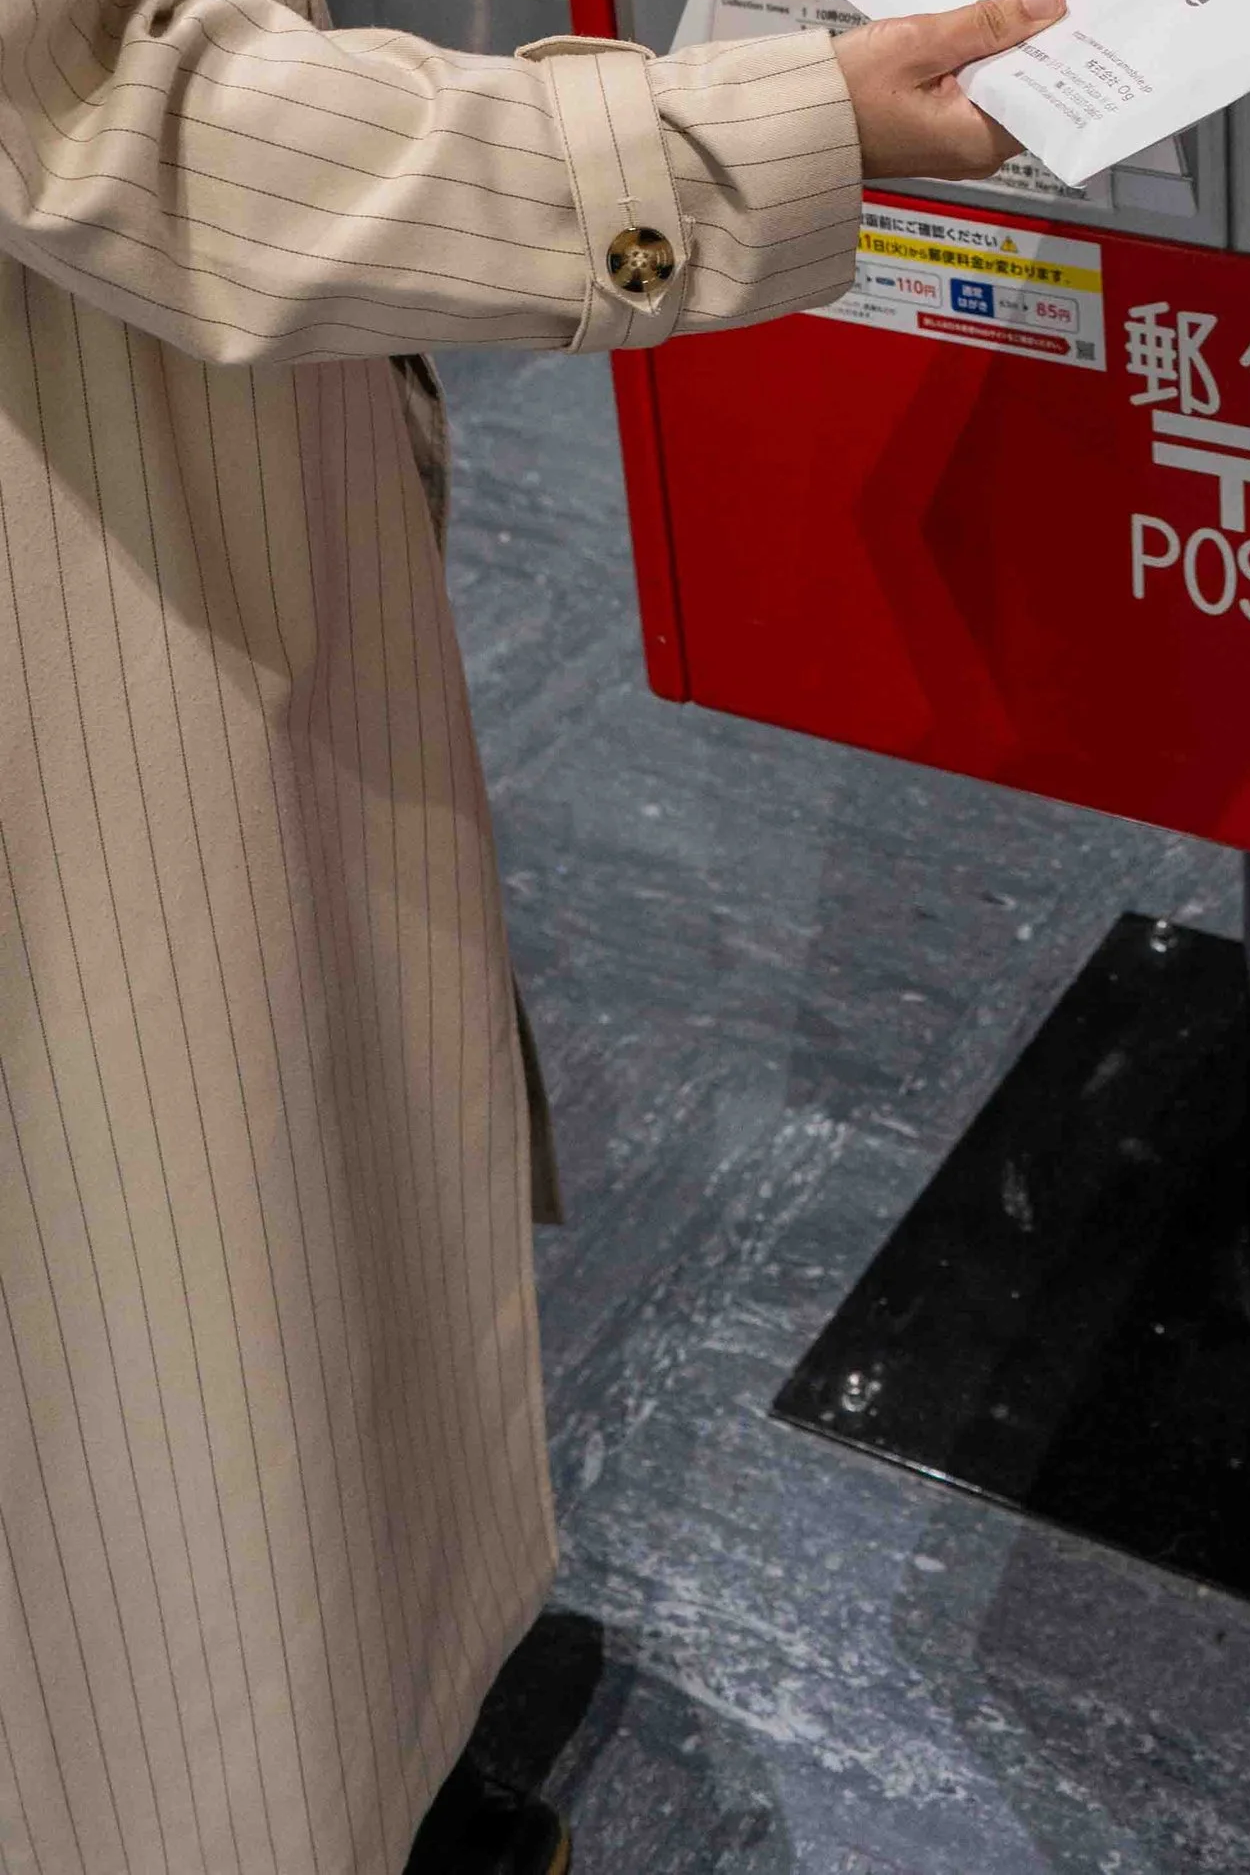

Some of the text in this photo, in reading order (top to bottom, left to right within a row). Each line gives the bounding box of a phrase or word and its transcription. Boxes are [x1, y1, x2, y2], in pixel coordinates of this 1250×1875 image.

[860, 213, 998, 249] 函前にご確認ください
[858, 233, 1071, 285] 1日(火)から郵便料金が変わります。
[896, 277, 937, 299] 110円
[1036, 301, 1071, 324] 85円
